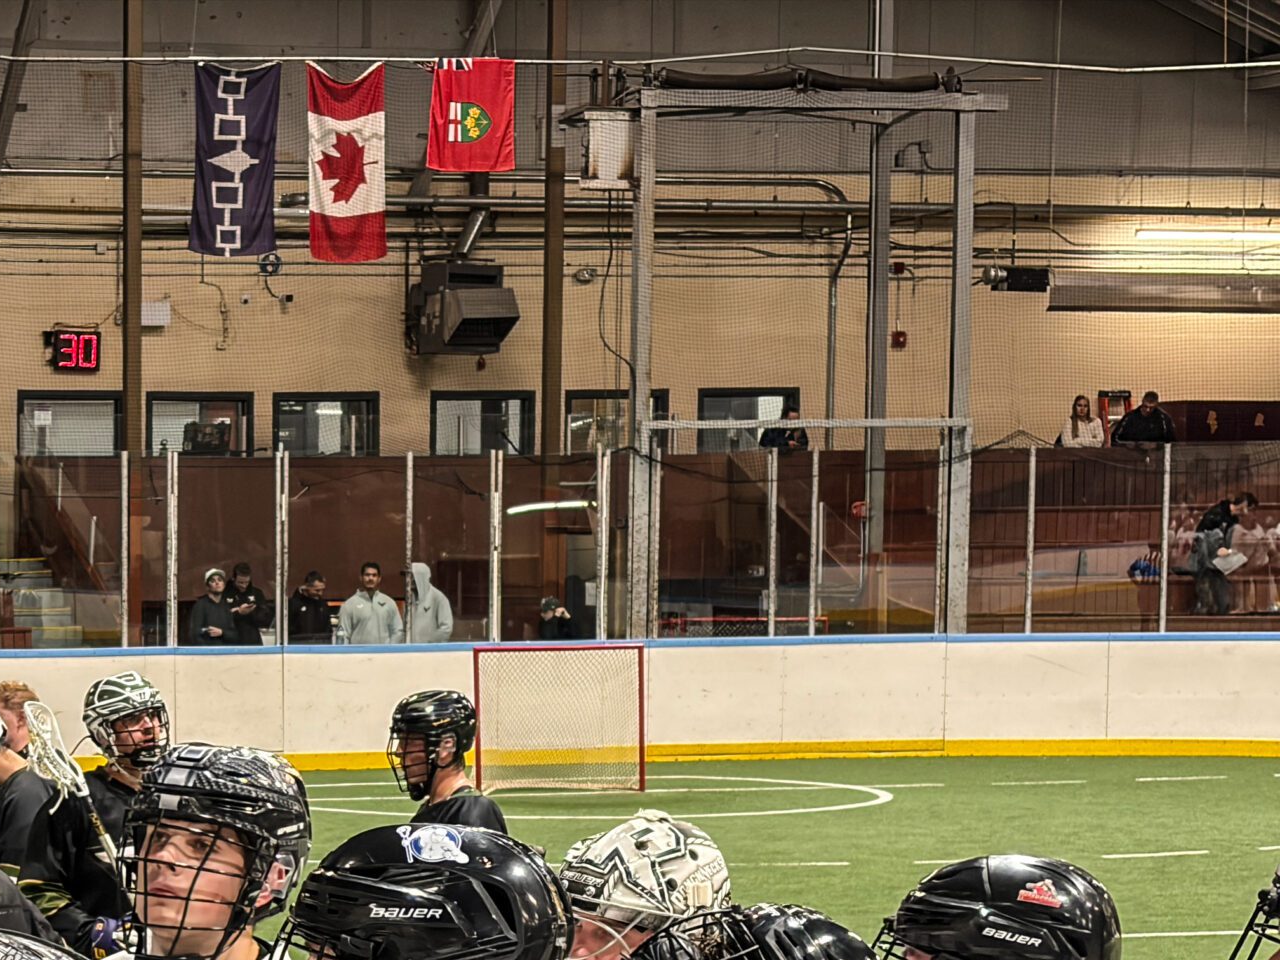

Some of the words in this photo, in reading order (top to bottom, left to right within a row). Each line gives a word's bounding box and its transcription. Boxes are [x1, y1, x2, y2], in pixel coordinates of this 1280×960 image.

[58, 333, 98, 368] 30
[368, 902, 443, 919] BAUER
[981, 926, 1043, 948] BAUER
